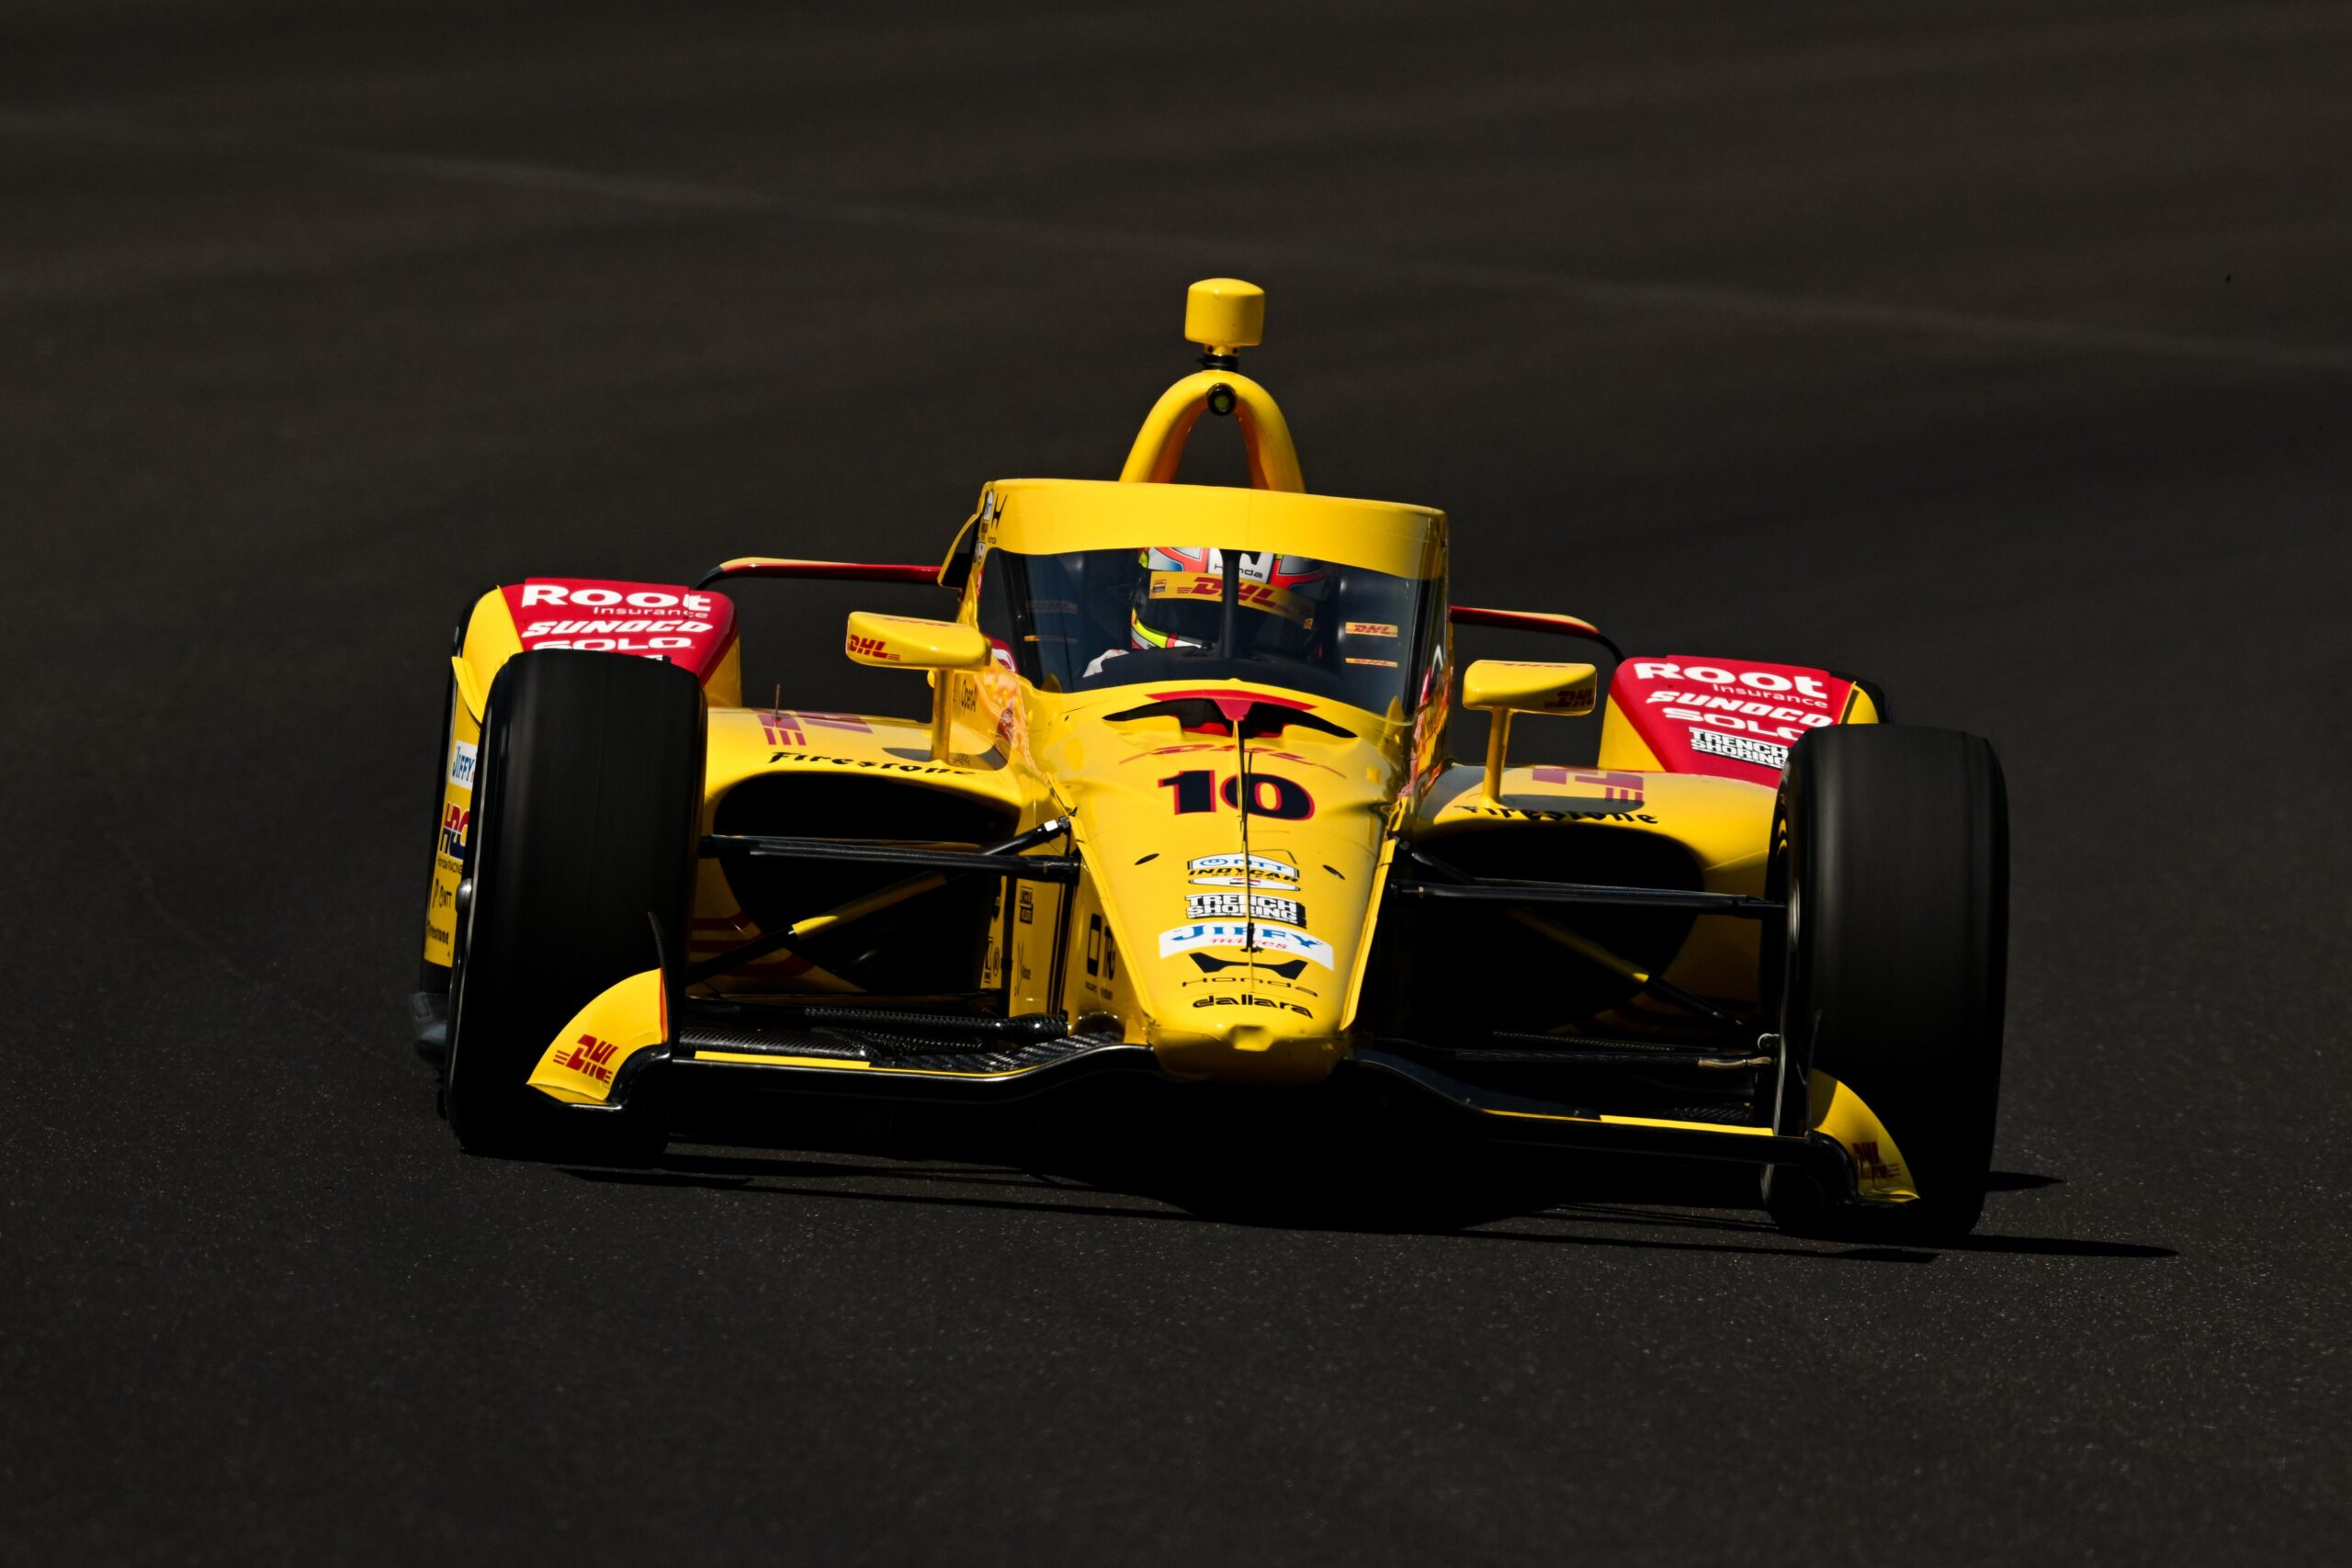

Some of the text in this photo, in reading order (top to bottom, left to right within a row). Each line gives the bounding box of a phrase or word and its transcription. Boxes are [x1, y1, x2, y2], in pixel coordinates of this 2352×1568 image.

[1191, 577, 1277, 607] DHL
[594, 606, 708, 619] Insurance
[521, 620, 714, 637] SUNOCO
[847, 634, 891, 659] DHL
[1713, 683, 1828, 709] Insurance
[1645, 690, 1834, 728] SUNOCO
[1689, 727, 1789, 759] TRENCH
[1690, 739, 1787, 766] SHORING
[452, 746, 475, 783] JIFFY
[768, 750, 977, 775] Firestone
[1158, 770, 1316, 821] 10
[1188, 867, 1299, 883] INDYCAR
[1185, 894, 1297, 913] TRENCH
[1186, 904, 1297, 922] SHORING
[1170, 925, 1322, 949] JIFFY
[1192, 994, 1314, 1020] dallara
